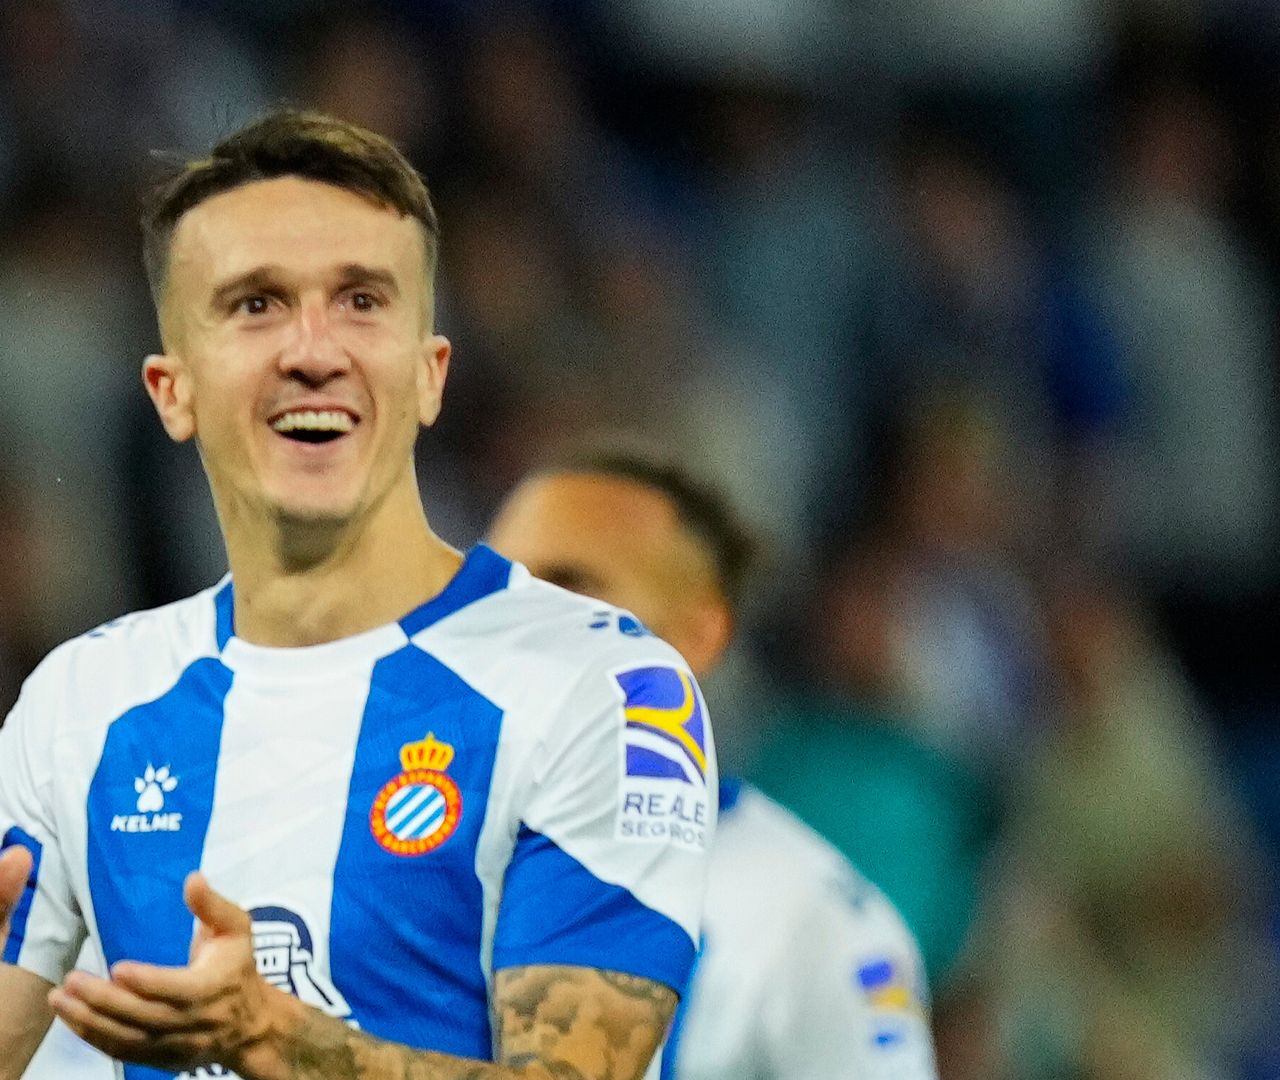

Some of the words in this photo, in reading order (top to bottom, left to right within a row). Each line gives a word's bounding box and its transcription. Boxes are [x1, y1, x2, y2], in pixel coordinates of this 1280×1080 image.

[110, 811, 183, 833] KELME
[623, 792, 706, 826] REALE
[621, 820, 706, 847] SEGROS
